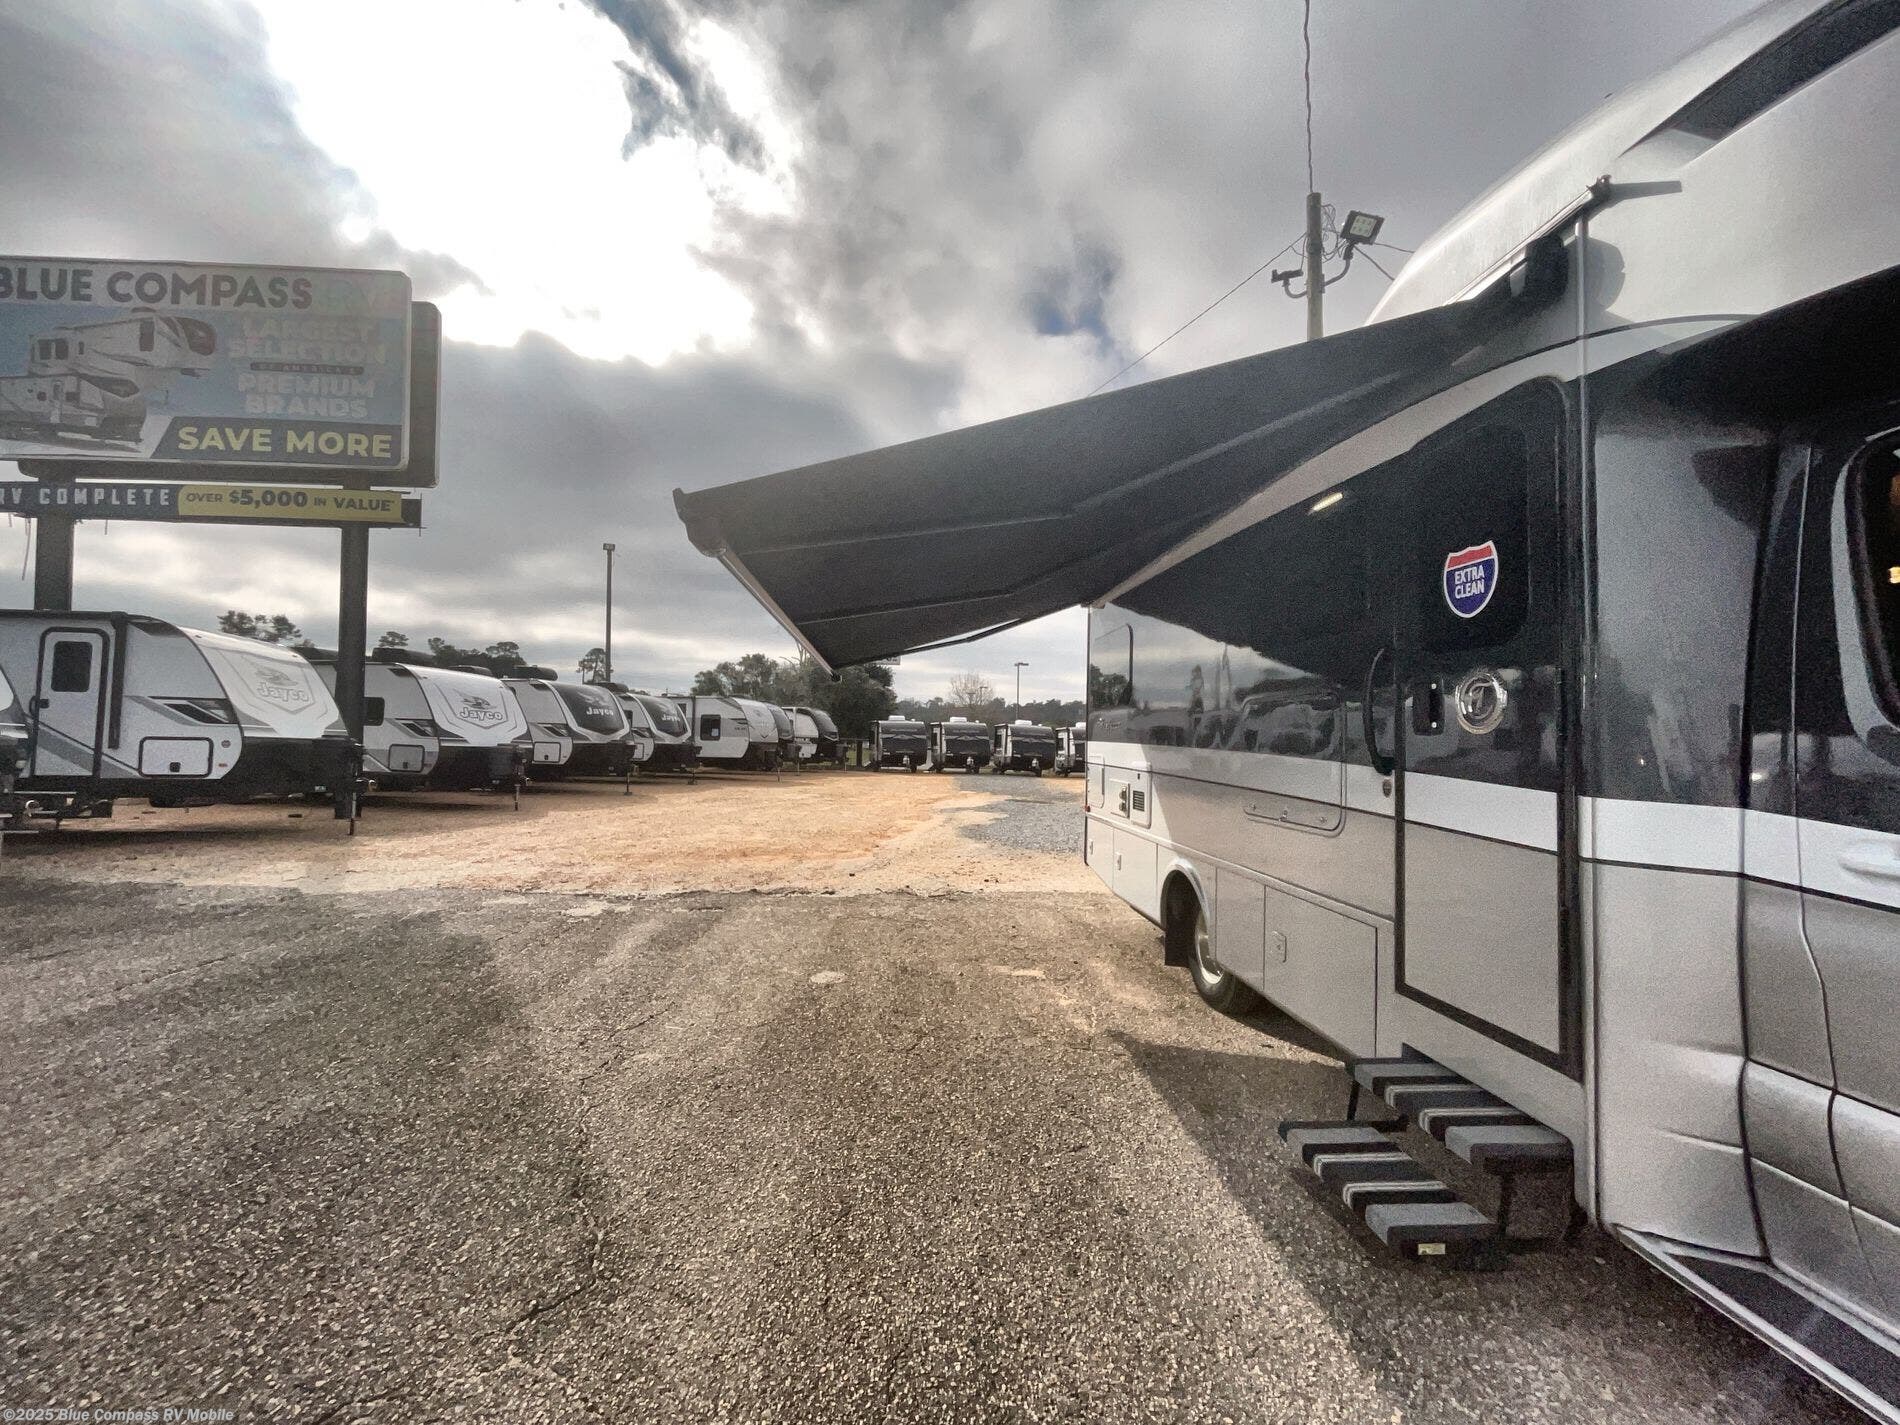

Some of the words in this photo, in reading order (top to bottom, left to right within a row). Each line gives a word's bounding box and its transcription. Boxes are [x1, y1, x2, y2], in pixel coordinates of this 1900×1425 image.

[0, 267, 93, 302] BLUE
[106, 269, 313, 309] COMPASS
[238, 373, 375, 397] PREMIUM
[245, 394, 368, 417] BRANDS
[178, 426, 272, 452] SAVE
[286, 430, 392, 458] MORE
[38, 487, 169, 506] COMPLETE
[186, 493, 223, 503] OVER
[229, 488, 307, 509] $5,000
[314, 498, 326, 507] IN
[1454, 564, 1485, 585] EXTRA
[1455, 579, 1485, 599] CLEAN
[256, 682, 310, 702] Jayco
[459, 706, 503, 721] Jayco
